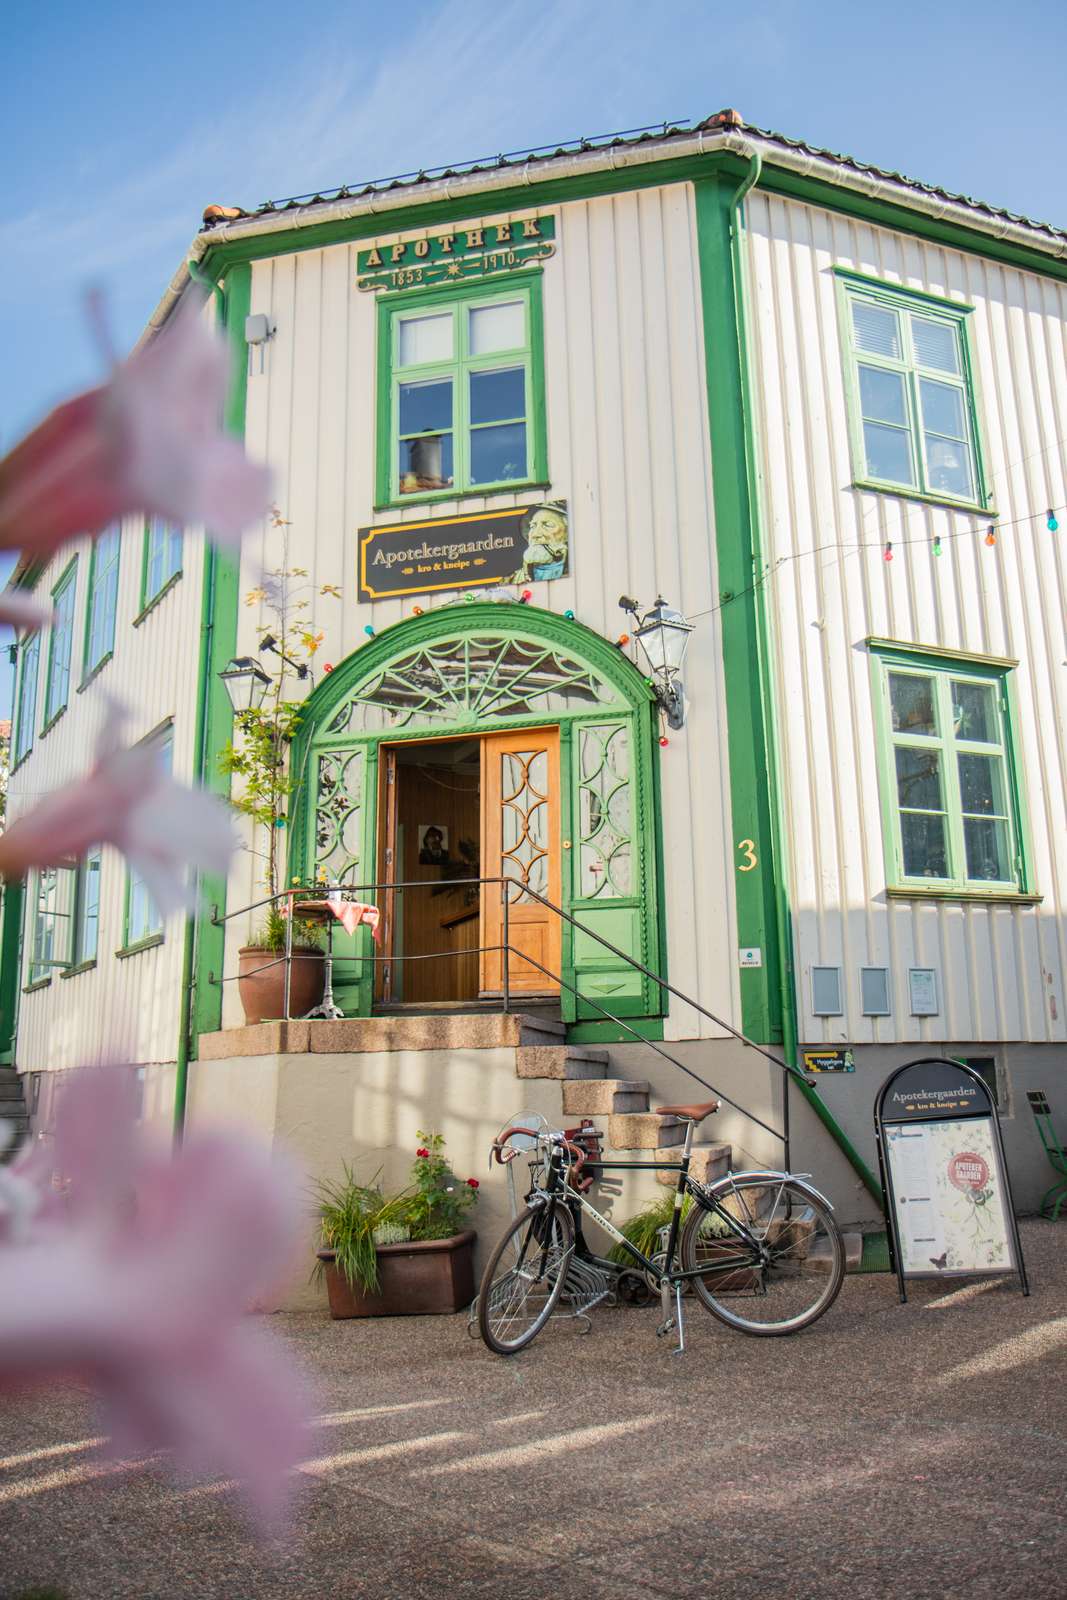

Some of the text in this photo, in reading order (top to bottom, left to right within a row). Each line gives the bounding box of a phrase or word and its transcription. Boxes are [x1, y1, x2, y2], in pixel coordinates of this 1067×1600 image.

[366, 219, 540, 266] APOTHEK
[391, 269, 424, 286] 1853
[372, 533, 515, 569] Apotekergaarden
[417, 557, 470, 573] kro & kneipe
[738, 839, 758, 872] 3
[892, 1086, 976, 1104] Apotekergaarden
